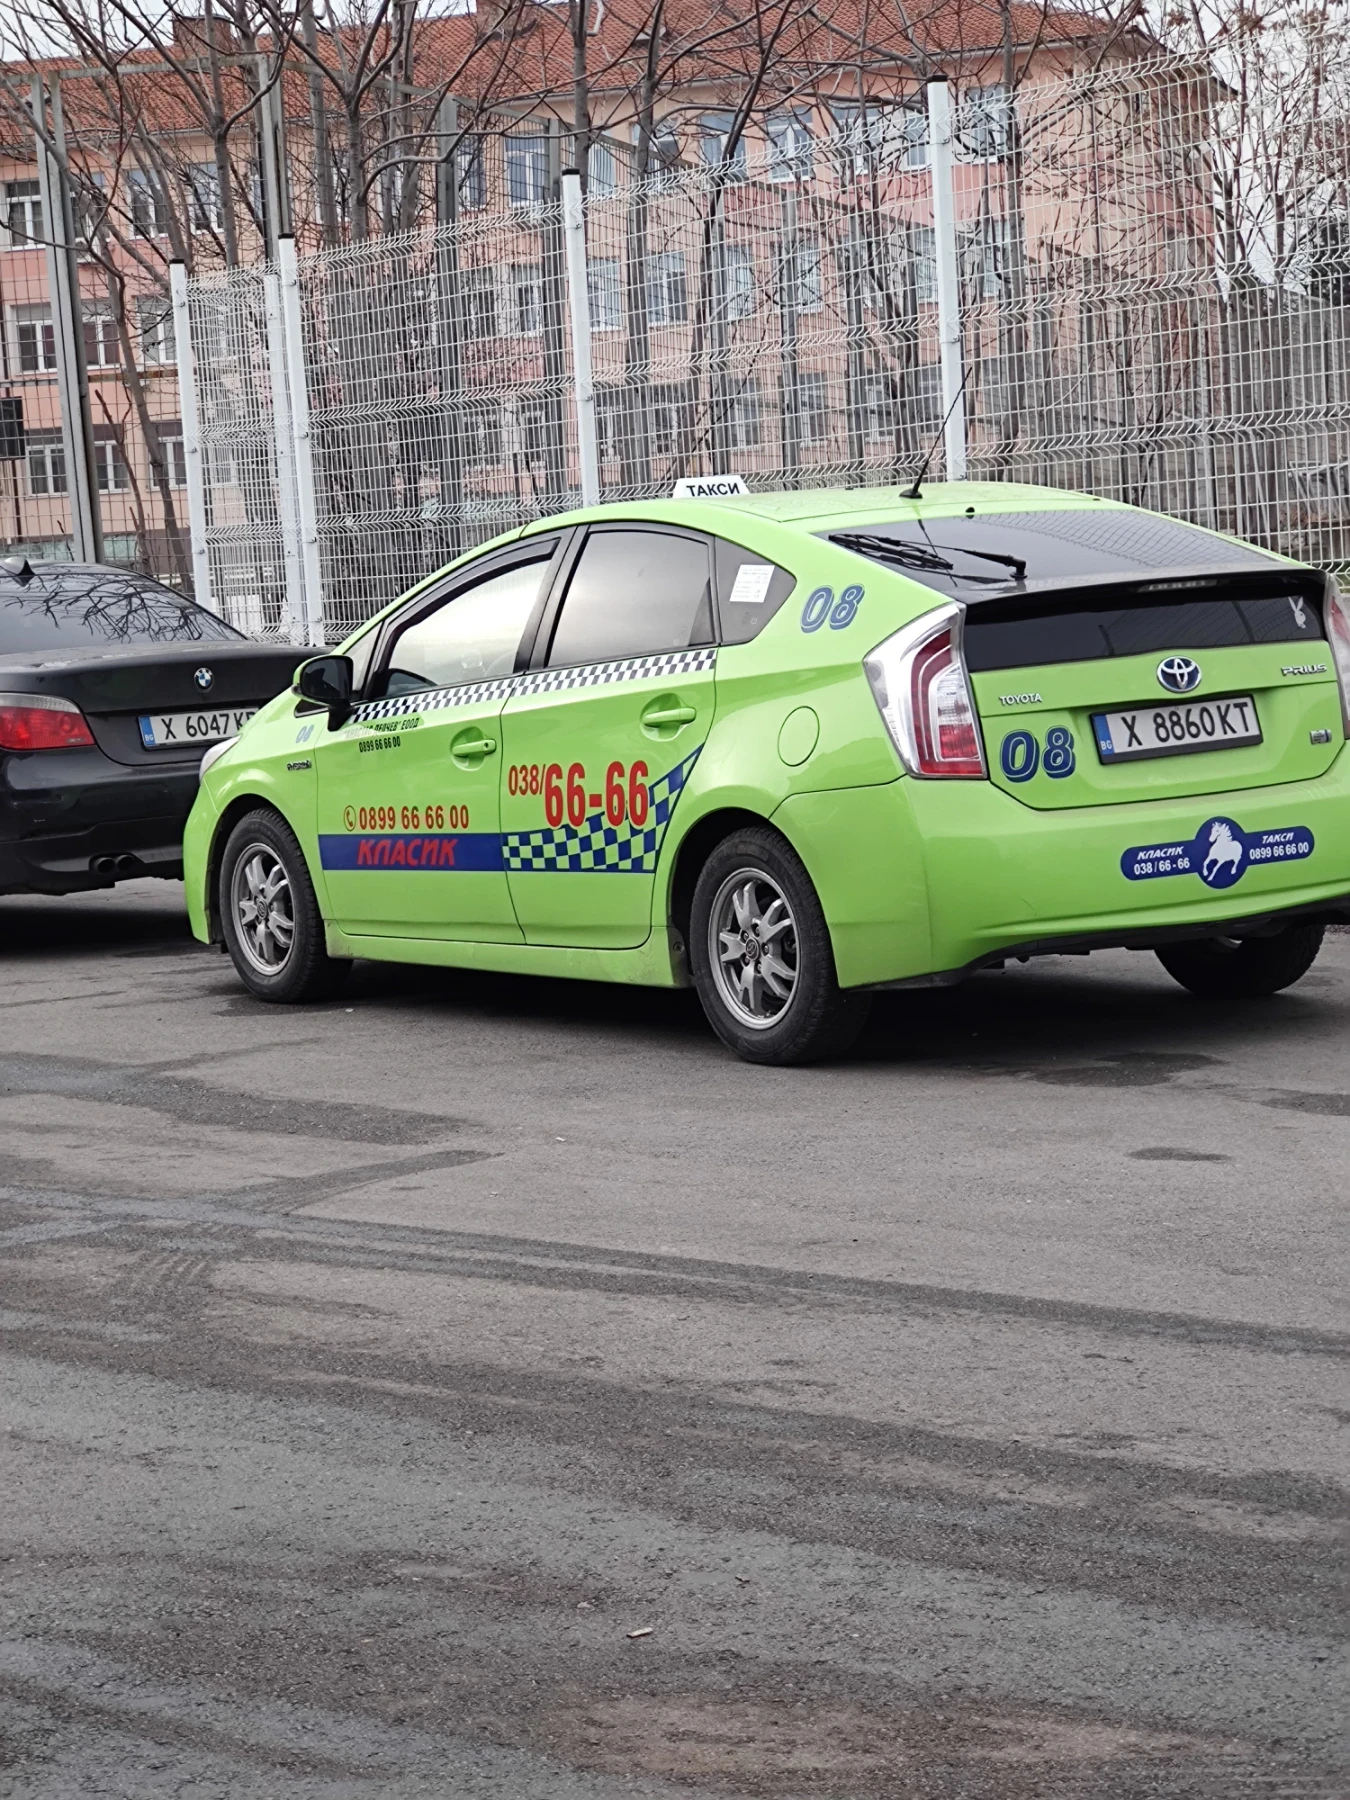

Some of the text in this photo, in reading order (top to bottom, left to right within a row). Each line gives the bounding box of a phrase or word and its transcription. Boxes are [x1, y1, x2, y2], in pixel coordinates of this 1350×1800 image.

[686, 483, 740, 497] ТАКСИ
[800, 583, 865, 633] 08
[1281, 664, 1327, 677] PRIUS
[999, 692, 1042, 706] TOYOTA
[145, 734, 154, 742] BG
[359, 735, 401, 752] 0899 66 66 00
[1100, 740, 1113, 750] BG
[1000, 725, 1076, 783] 08
[360, 805, 469, 830] 0899 66 66 00
[1262, 832, 1294, 844] ТАКСИ
[357, 838, 459, 866] КЛАСИК
[1137, 846, 1184, 860] КЛАСИК
[1249, 841, 1309, 860] 0899 66 66 00
